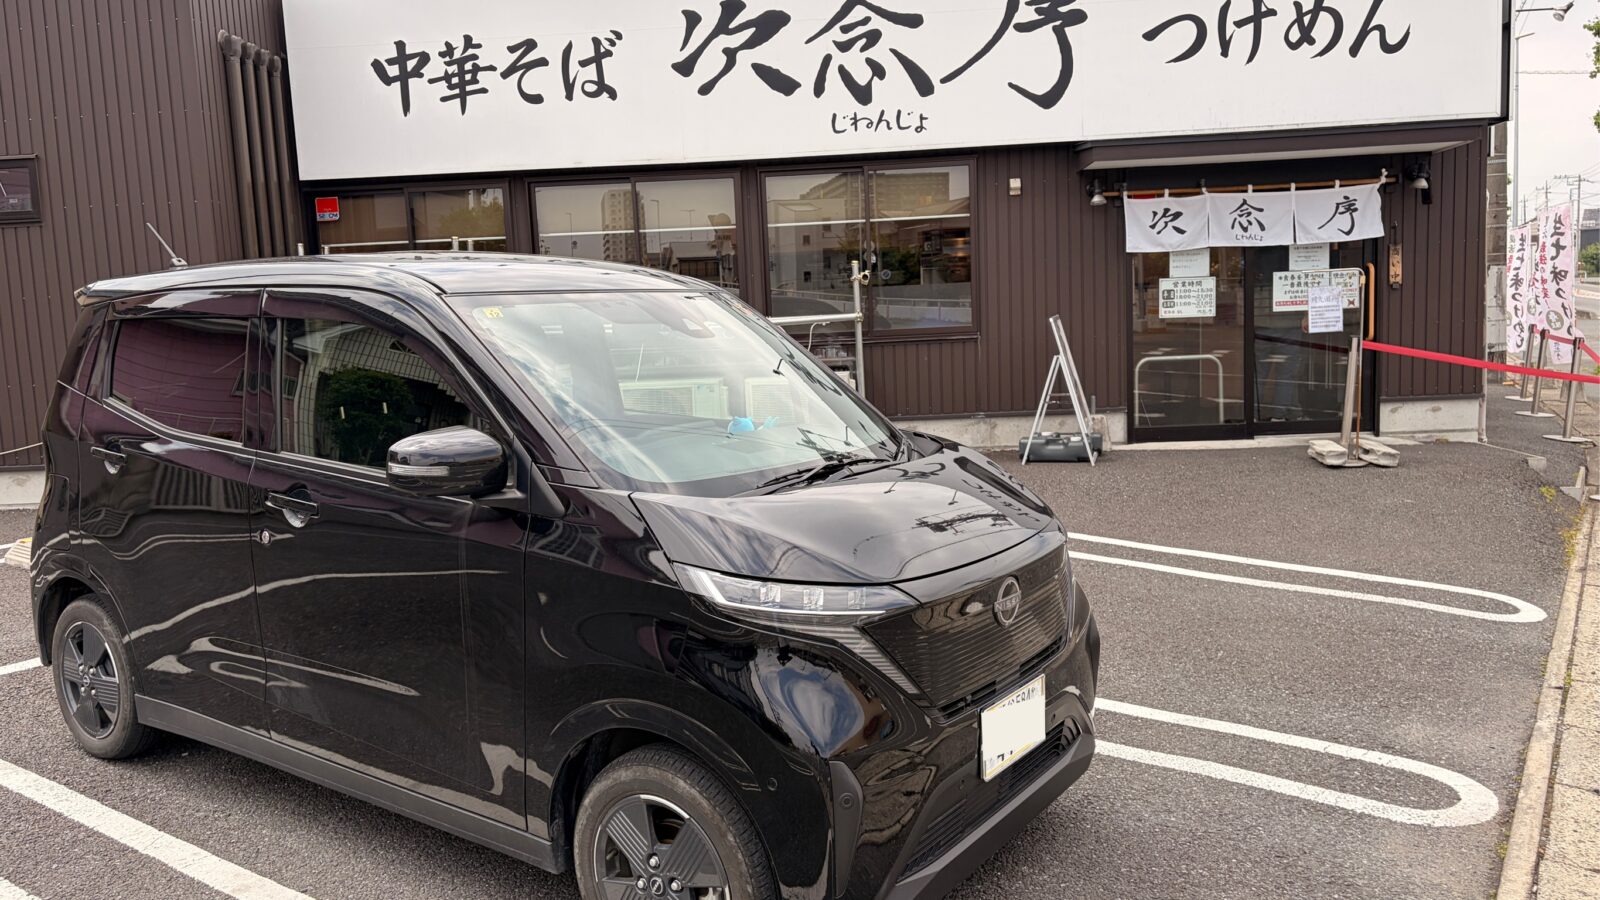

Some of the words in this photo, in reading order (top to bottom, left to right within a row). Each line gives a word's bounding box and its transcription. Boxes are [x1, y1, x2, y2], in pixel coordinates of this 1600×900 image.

[371, 29, 623, 117] 中華そば
[670, 0, 1088, 110] 次念序
[1142, 0, 1411, 65] つけめん
[831, 109, 929, 134] じねんじょ
